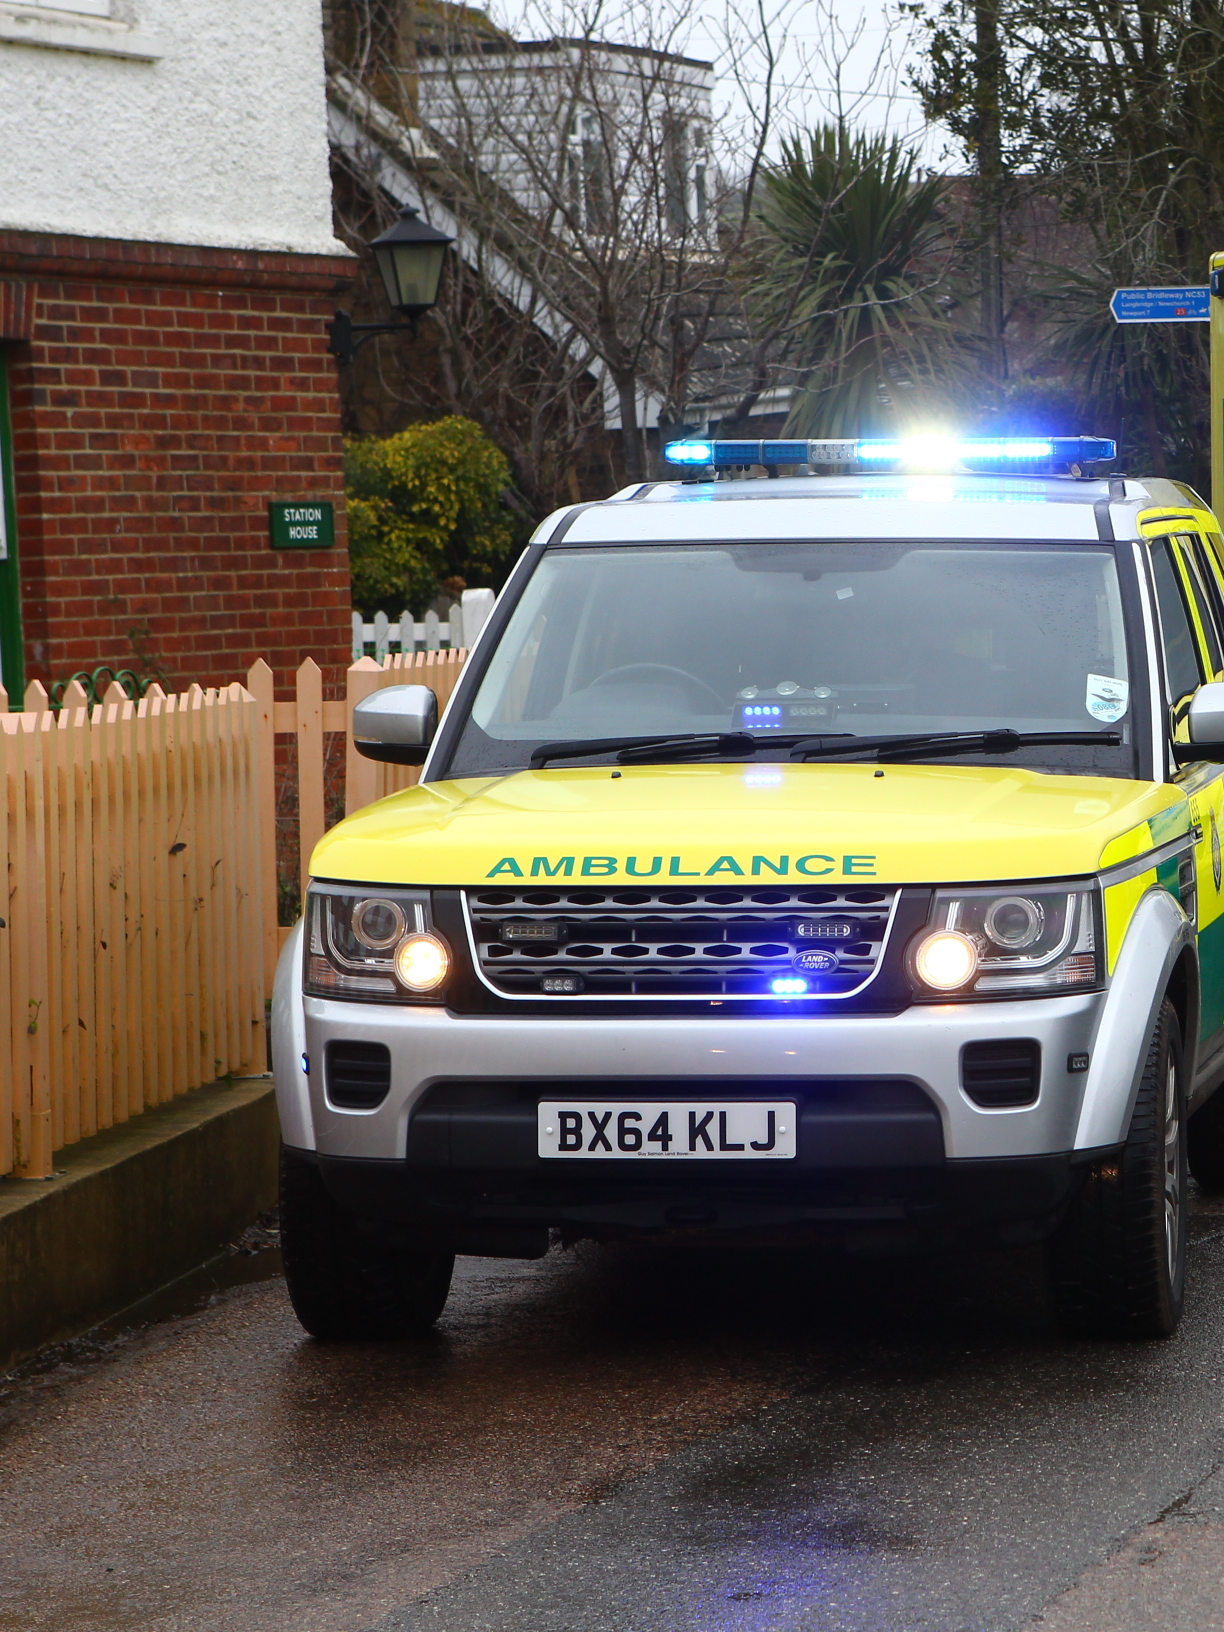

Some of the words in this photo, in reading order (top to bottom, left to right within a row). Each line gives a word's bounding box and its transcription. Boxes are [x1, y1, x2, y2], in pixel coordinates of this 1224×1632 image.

[1146, 291, 1184, 299] Bridleway
[284, 508, 322, 521] STATION
[289, 526, 318, 539] HOUSE
[485, 855, 878, 878] AMBULANCE
[557, 1110, 673, 1152] BX64
[689, 1110, 776, 1152] KLJ
